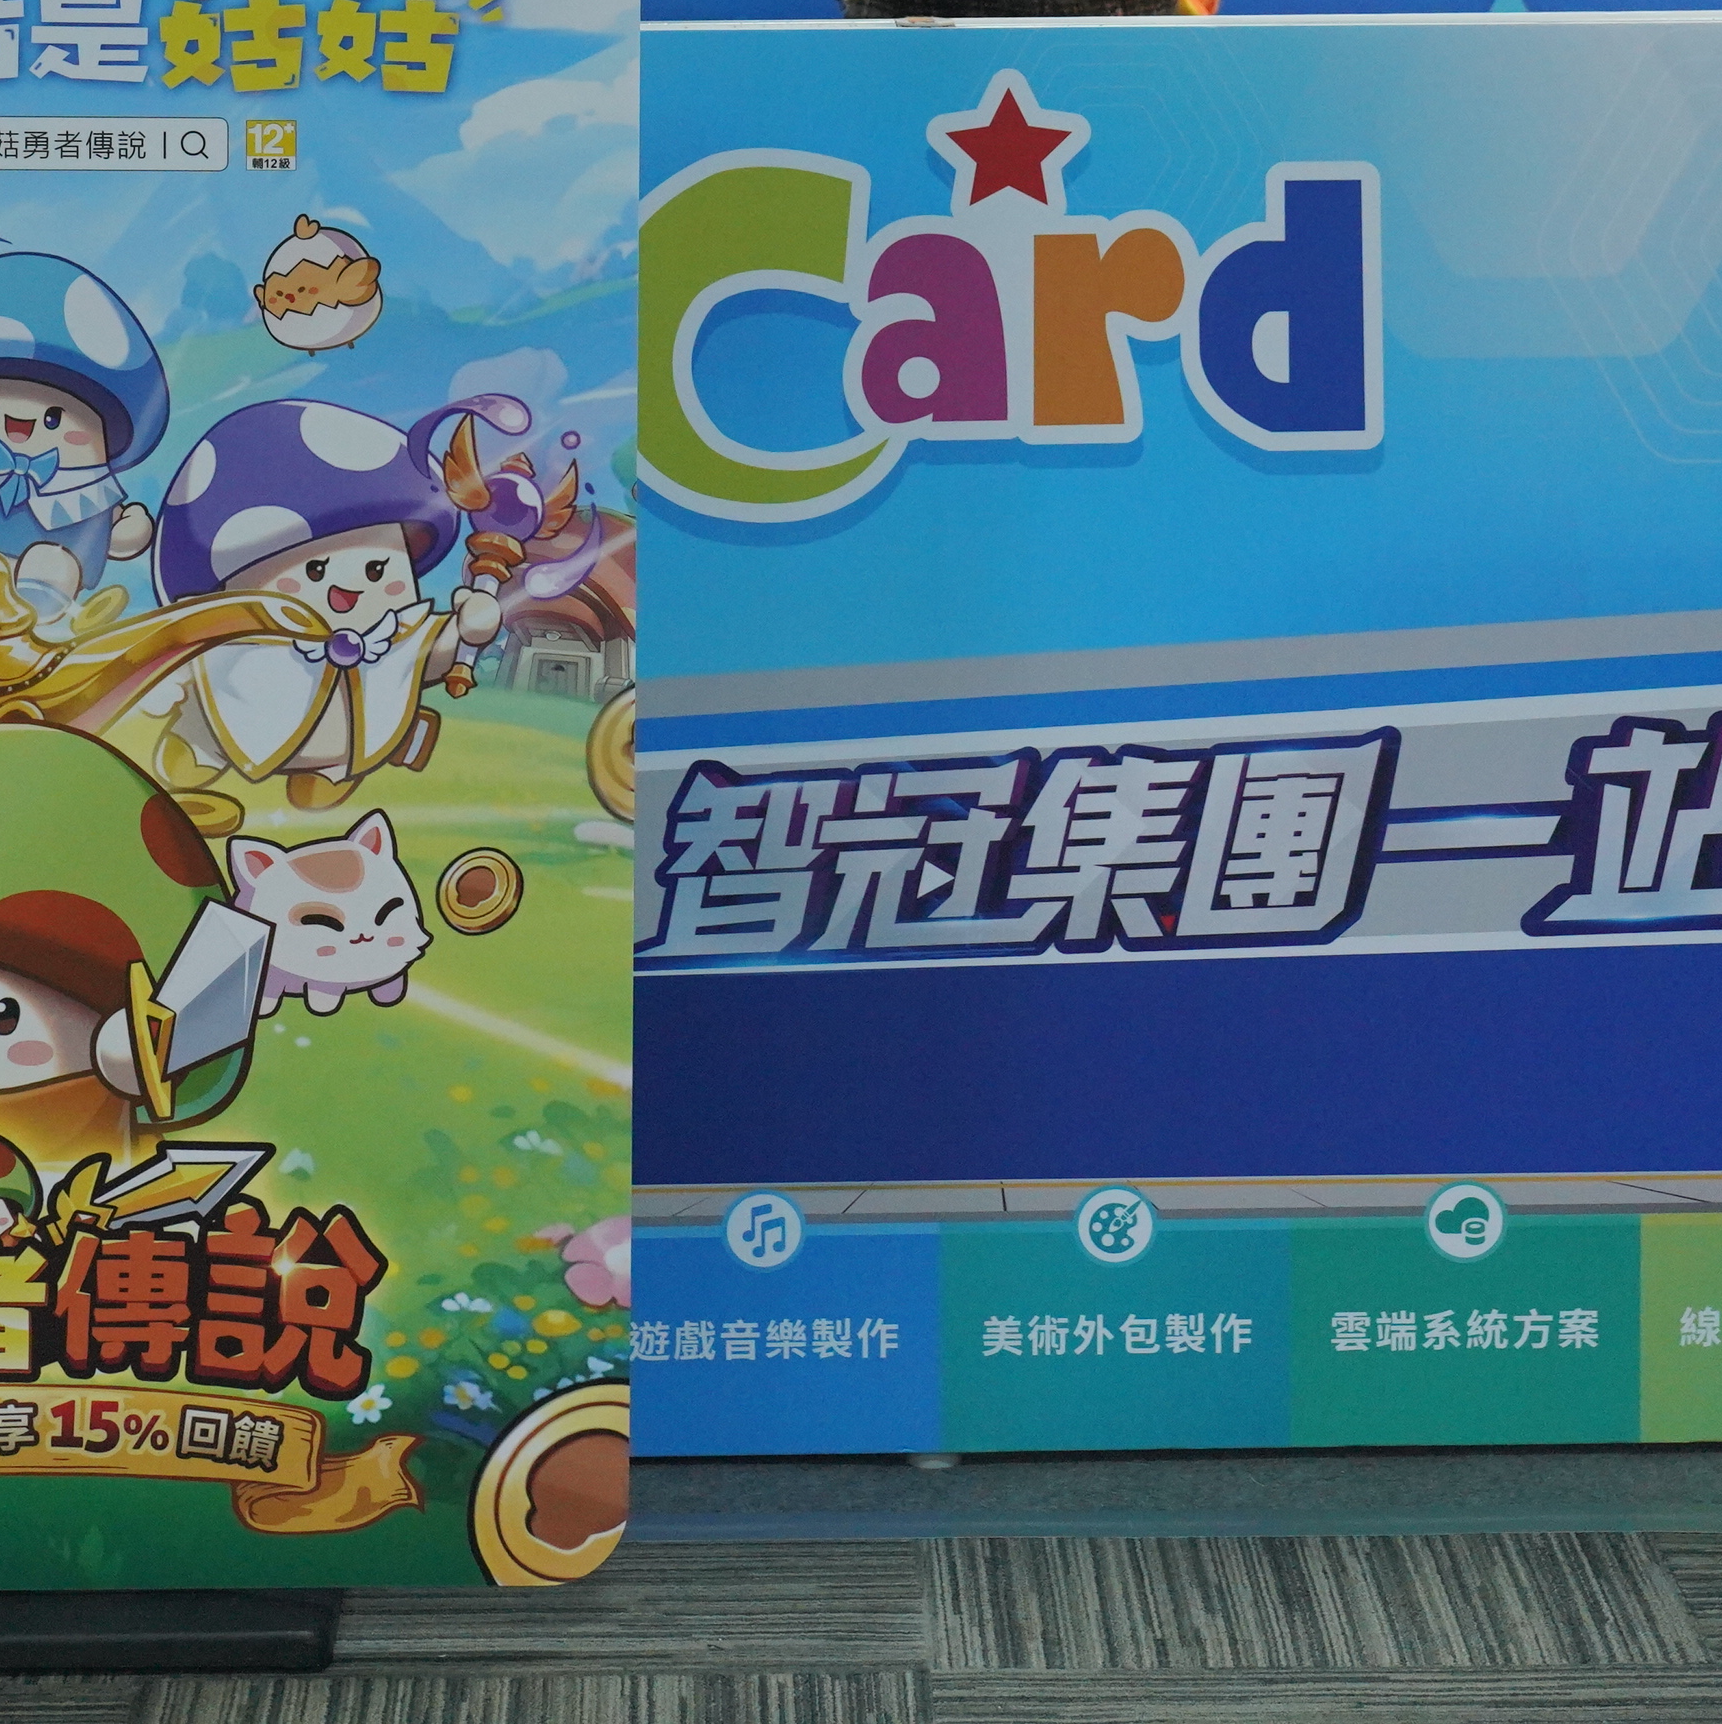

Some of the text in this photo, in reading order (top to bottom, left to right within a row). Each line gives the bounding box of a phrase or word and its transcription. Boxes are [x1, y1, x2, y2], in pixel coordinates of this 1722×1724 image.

[251, 157, 293, 170] 輔12級
[630, 1317, 900, 1362] 遊戲音樂製作
[981, 1313, 1253, 1358] 美術外包製作
[1329, 1306, 1602, 1354] 雲端系統方案
[48, 1398, 170, 1455] 15%
[178, 1407, 286, 1472] 回饋
